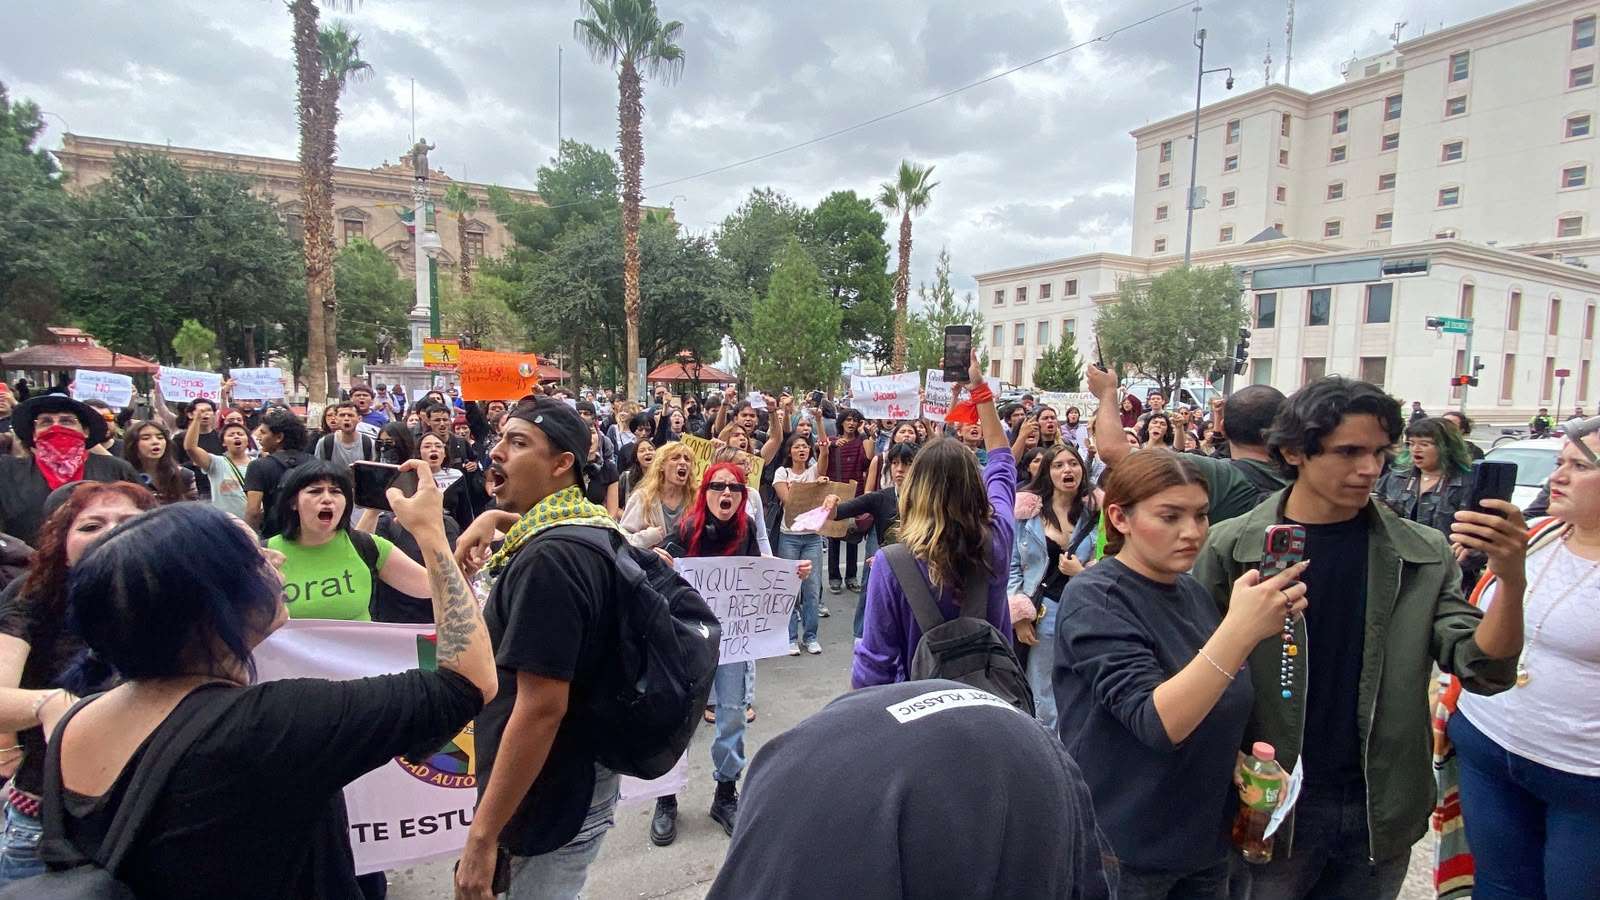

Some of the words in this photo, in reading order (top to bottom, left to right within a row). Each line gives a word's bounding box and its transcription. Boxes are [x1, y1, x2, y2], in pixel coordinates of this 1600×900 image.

[760, 569, 790, 590] SE
[754, 617, 772, 633] EL
[898, 693, 965, 716] KLASSIC
[430, 773, 476, 787] AUTO
[351, 822, 389, 843] TE
